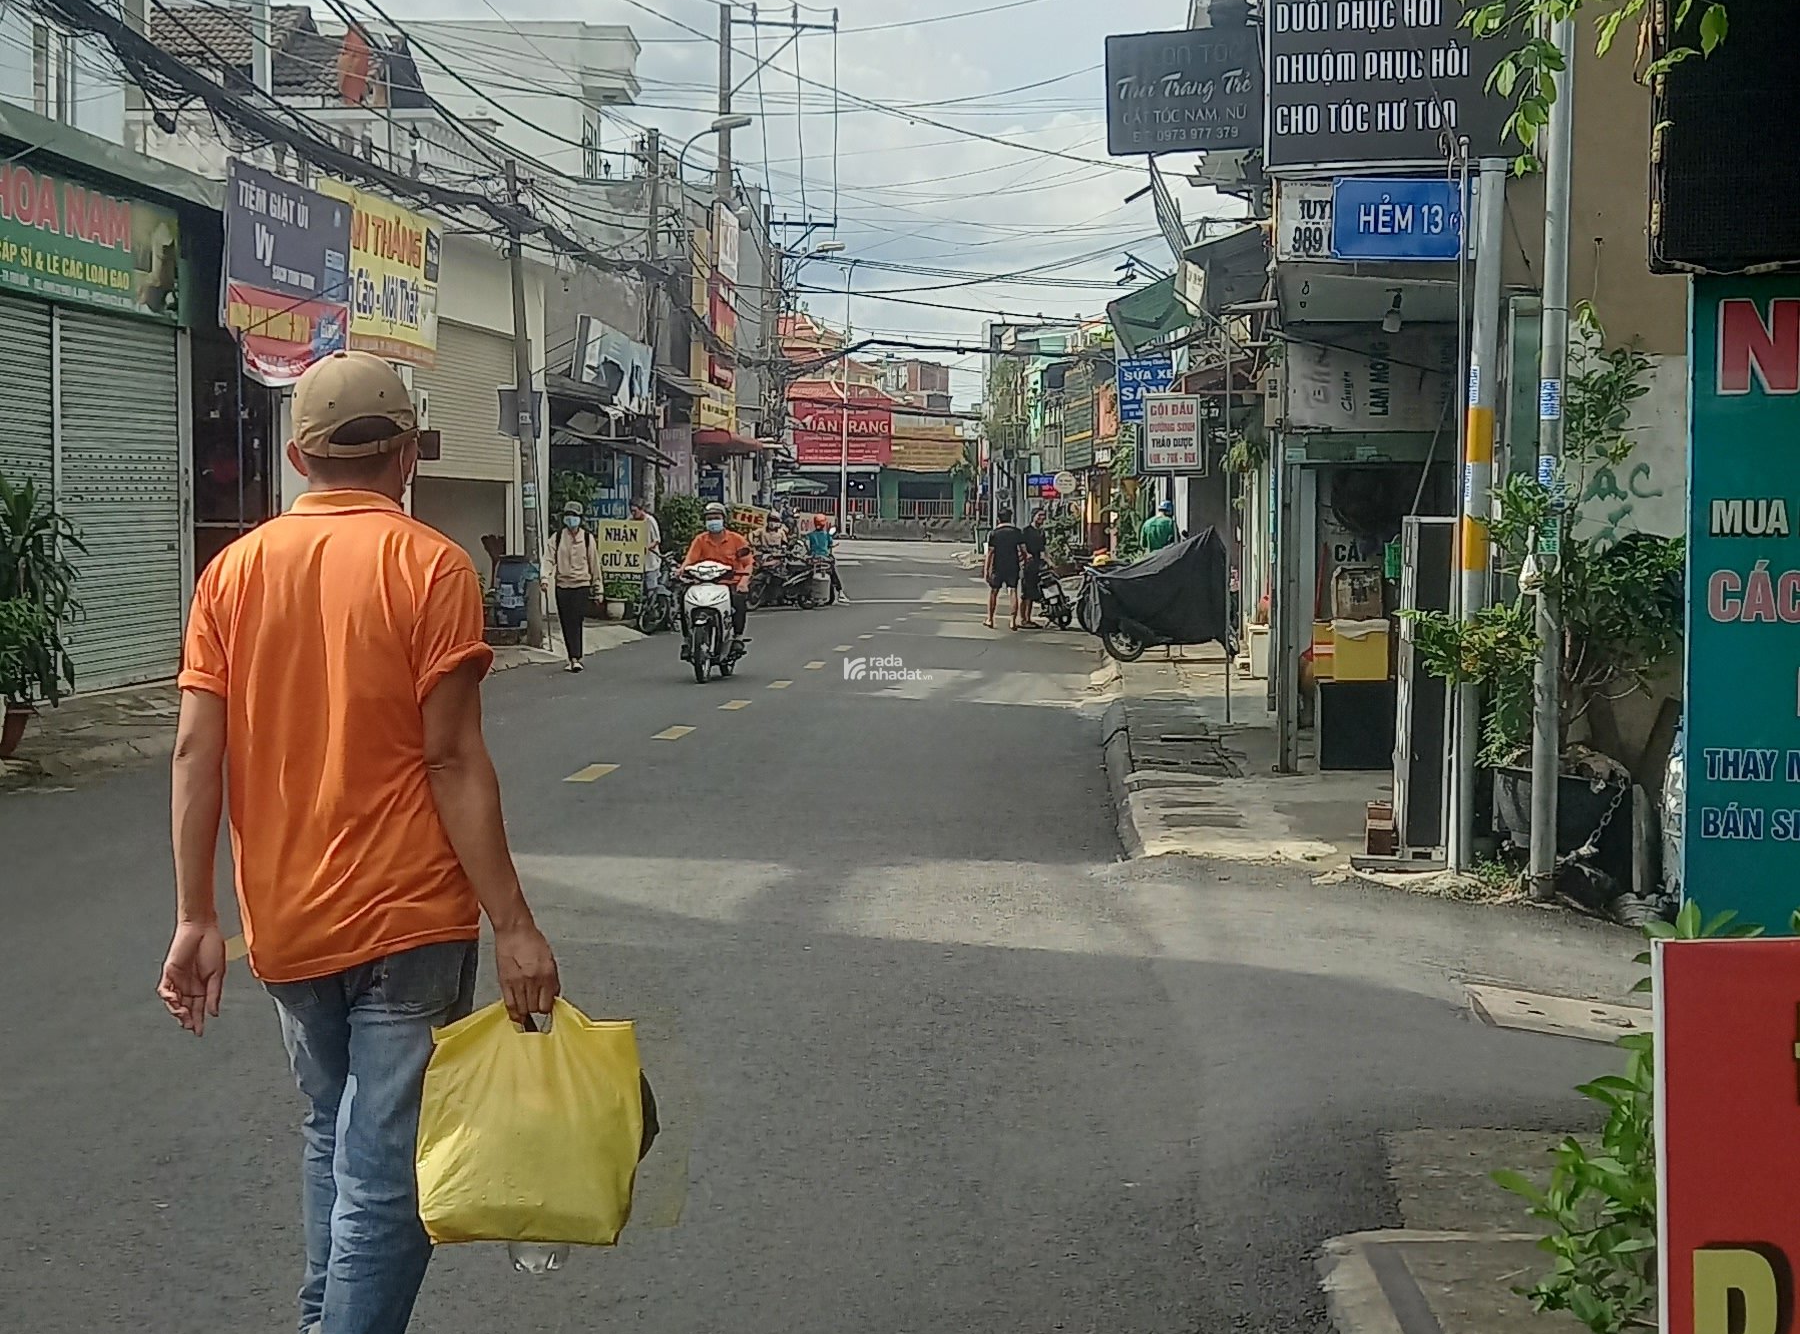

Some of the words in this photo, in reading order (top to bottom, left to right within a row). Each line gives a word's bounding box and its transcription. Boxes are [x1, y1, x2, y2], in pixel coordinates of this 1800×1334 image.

[1337, 0, 1396, 34] PHỤC
[1276, 49, 1356, 86] NHUỘM
[1365, 50, 1424, 84] PHỤC
[1431, 38, 1470, 78] HỒI
[1160, 72, 1215, 104] Trang
[1153, 107, 1180, 124] TÓC
[1225, 104, 1248, 120] NỮ
[1276, 105, 1320, 135] CHO
[1327, 99, 1370, 133] TÓC
[1377, 97, 1408, 132] HƯ
[1157, 127, 1186, 142] 0973
[1190, 127, 1212, 140] 977
[1216, 126, 1239, 139] 379
[64, 182, 131, 253] NAM
[238, 179, 267, 216] TIỆM
[269, 192, 295, 227] GIẶT
[297, 195, 309, 229] ỦI
[1359, 194, 1413, 233] HẺM
[1421, 204, 1443, 234] 13
[255, 222, 275, 267] Vy
[1292, 226, 1324, 253] 989
[36, 251, 44, 272] &
[62, 255, 83, 280] CÁC
[86, 263, 108, 289] LOẠI
[109, 269, 130, 292] GẠO
[1157, 369, 1173, 380] XE
[605, 524, 638, 546] NHẬN
[1710, 499, 1790, 535] MUA
[601, 549, 623, 567] GIỮ
[625, 554, 640, 567] XE
[1707, 559, 1800, 623] CÁC
[1703, 748, 1779, 782] THAY
[1701, 801, 1764, 840] BÁN
